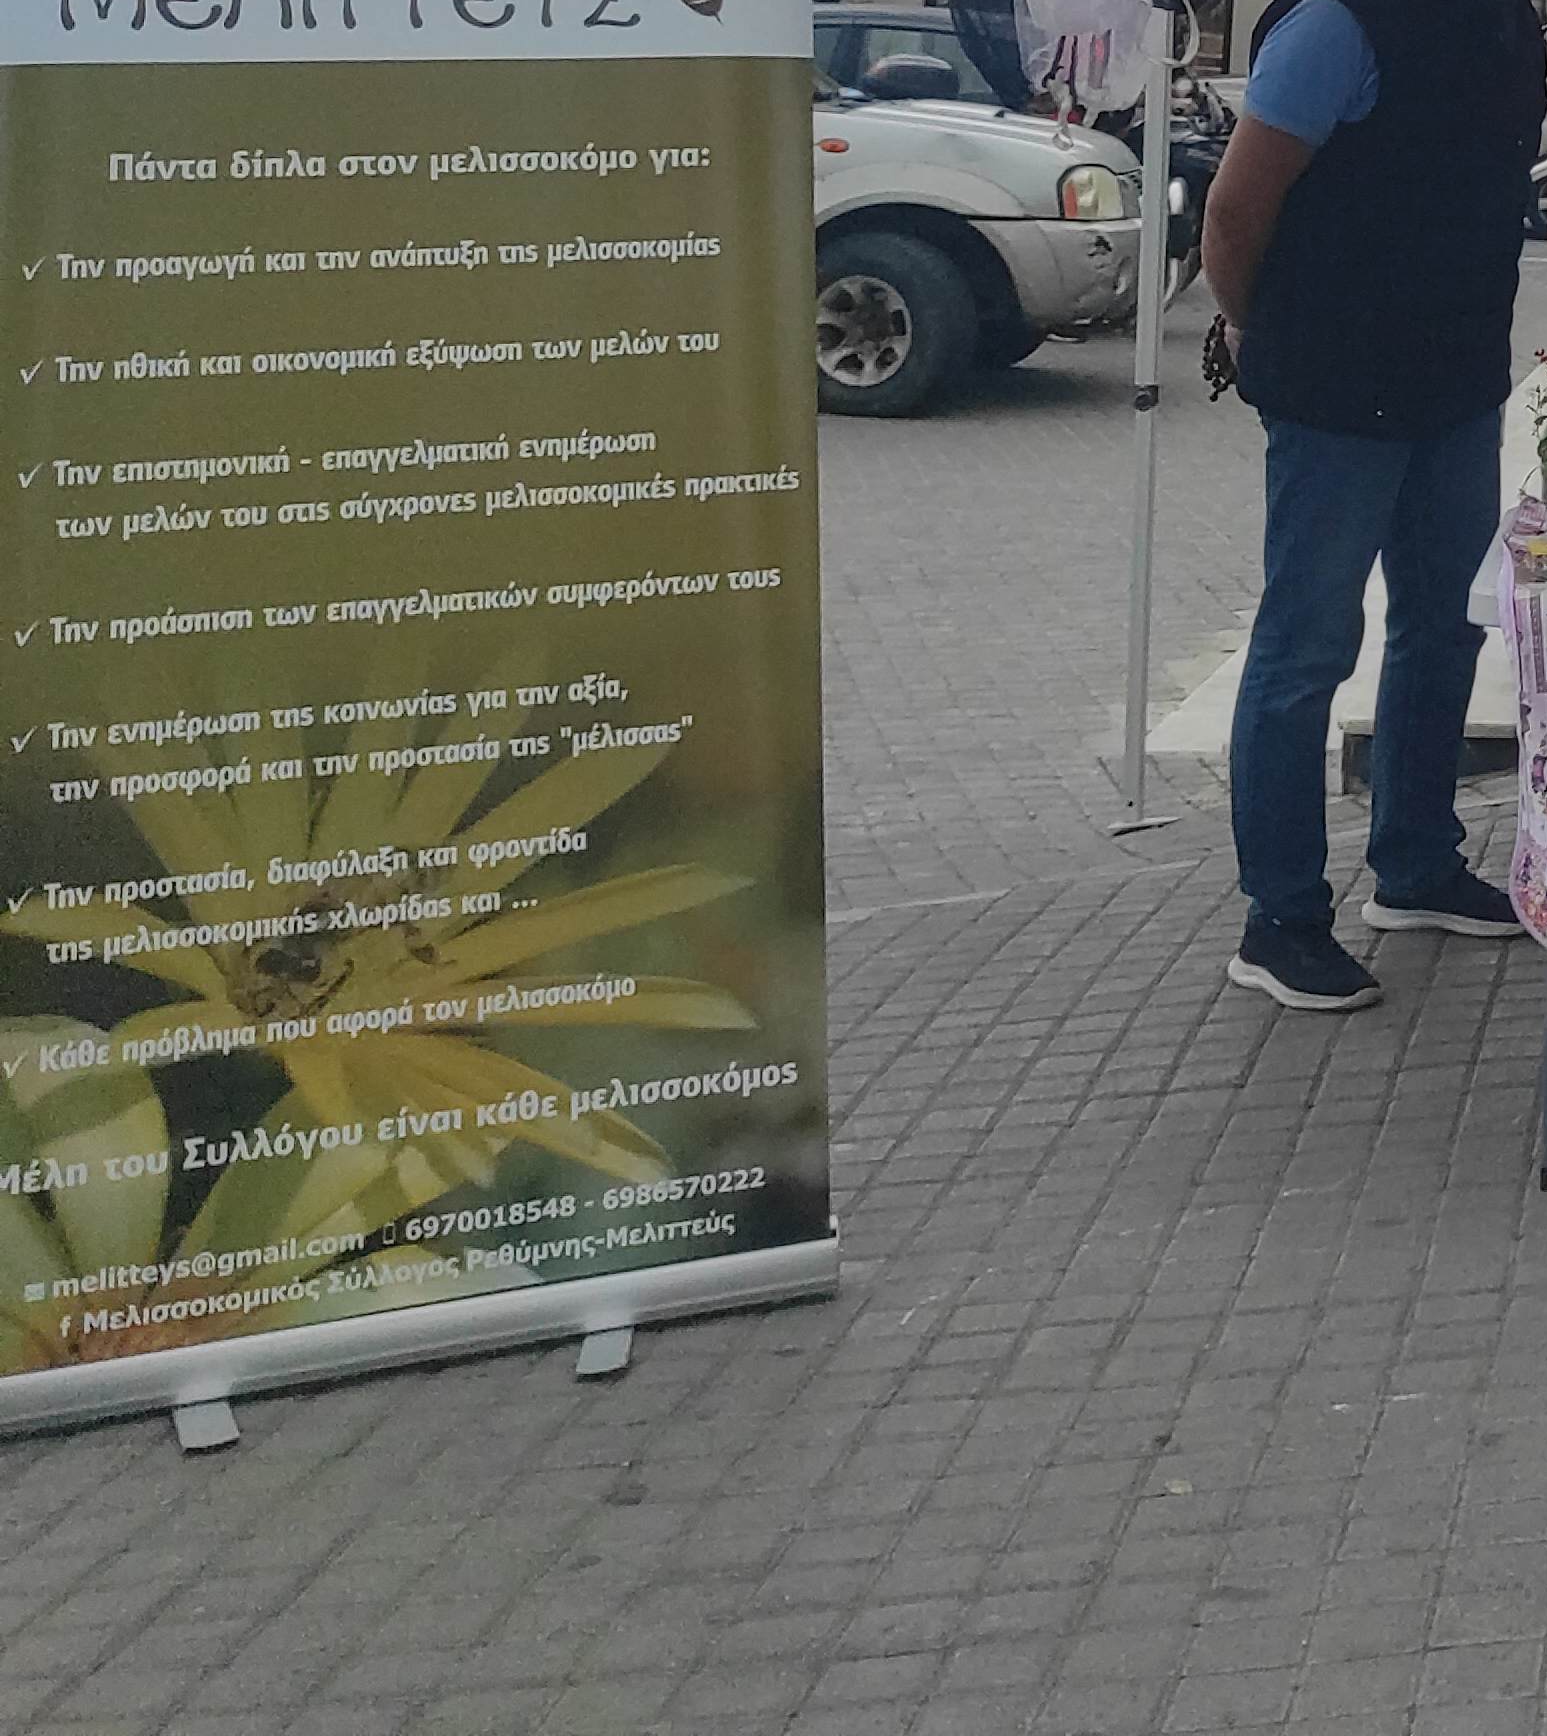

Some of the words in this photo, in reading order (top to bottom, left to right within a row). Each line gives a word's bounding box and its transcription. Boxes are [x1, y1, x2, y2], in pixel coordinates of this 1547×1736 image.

[109, 151, 217, 182] Πάντα
[230, 149, 325, 179] δίπλα
[339, 154, 418, 178] στον
[430, 142, 637, 180] μελισσοκόμο
[648, 145, 711, 175] για:
[56, 252, 105, 281] Την
[115, 245, 255, 284] προαγωγή
[265, 253, 306, 273] και
[316, 249, 362, 272] την
[369, 239, 489, 272] ανάπτυξη
[497, 243, 538, 266] της
[546, 231, 722, 269] μελισσοκομίας
[55, 355, 104, 385] Την
[113, 348, 191, 381] ηθική
[200, 353, 241, 376] και
[251, 340, 397, 377] οικονομική
[405, 337, 523, 372] εξύψωση
[531, 339, 583, 361] των
[590, 328, 669, 364] μελών
[677, 331, 720, 353] του
[52, 458, 102, 488] Την
[112, 444, 291, 485] επιστημονική
[321, 433, 509, 475] επαγγελματική
[518, 428, 657, 463] ενημέρωση
[56, 515, 113, 540] των
[123, 503, 213, 542] μελών
[221, 506, 268, 529] του
[277, 500, 330, 524] στις
[339, 490, 477, 525] σύγχρονες
[485, 471, 676, 517] μελισσοκομικές
[684, 465, 801, 503] πρακτικές
[49, 615, 99, 645] Την
[108, 606, 254, 645] προάσπιση
[263, 603, 318, 627] των
[326, 580, 538, 625] επαγγελματικών
[546, 570, 720, 609] συμφερόντων
[727, 567, 782, 591] τους
[47, 721, 97, 752] Την
[107, 709, 262, 750] ενημέρωση
[270, 704, 315, 730] της
[323, 688, 458, 725] κοινωνίας
[466, 690, 508, 718] για
[516, 682, 561, 707] την
[568, 672, 630, 707] αξία,
[50, 776, 99, 804] την
[109, 756, 252, 802] προσφορά
[261, 758, 303, 783] και
[313, 752, 359, 776] την
[368, 733, 501, 773] προστασία
[508, 734, 552, 758] της
[559, 714, 694, 758] "μέλισσας"
[44, 882, 97, 911] Την
[104, 862, 256, 909] προστασία,
[266, 845, 409, 887] διαφύλαξη
[417, 844, 458, 870] και
[467, 827, 588, 869] φροντίδα
[46, 940, 93, 966] της
[103, 909, 320, 965] μελισσοκομικής
[326, 892, 453, 931] χλωρίδας
[460, 891, 502, 914] και
[39, 1041, 111, 1074] Κάθε
[121, 1022, 257, 1067] πρόβλημα
[265, 1016, 318, 1044] που
[326, 997, 413, 1038] αφορά
[423, 997, 468, 1023] τον
[476, 973, 637, 1021] μελισσοκόμο
[104, 1151, 169, 1182] του
[182, 1122, 363, 1172] Συλλόγου
[376, 1106, 463, 1142] είναι
[476, 1089, 558, 1128] κάθε
[569, 1061, 799, 1120] μελισσοκόμος
[52, 1230, 366, 1300] melitteys@gmail.com
[403, 1195, 577, 1241] 6970018548
[602, 1166, 767, 1212] 6986570222
[83, 1277, 322, 1335] Μελισσοκομικός
[327, 1257, 460, 1295] Σύλλογος
